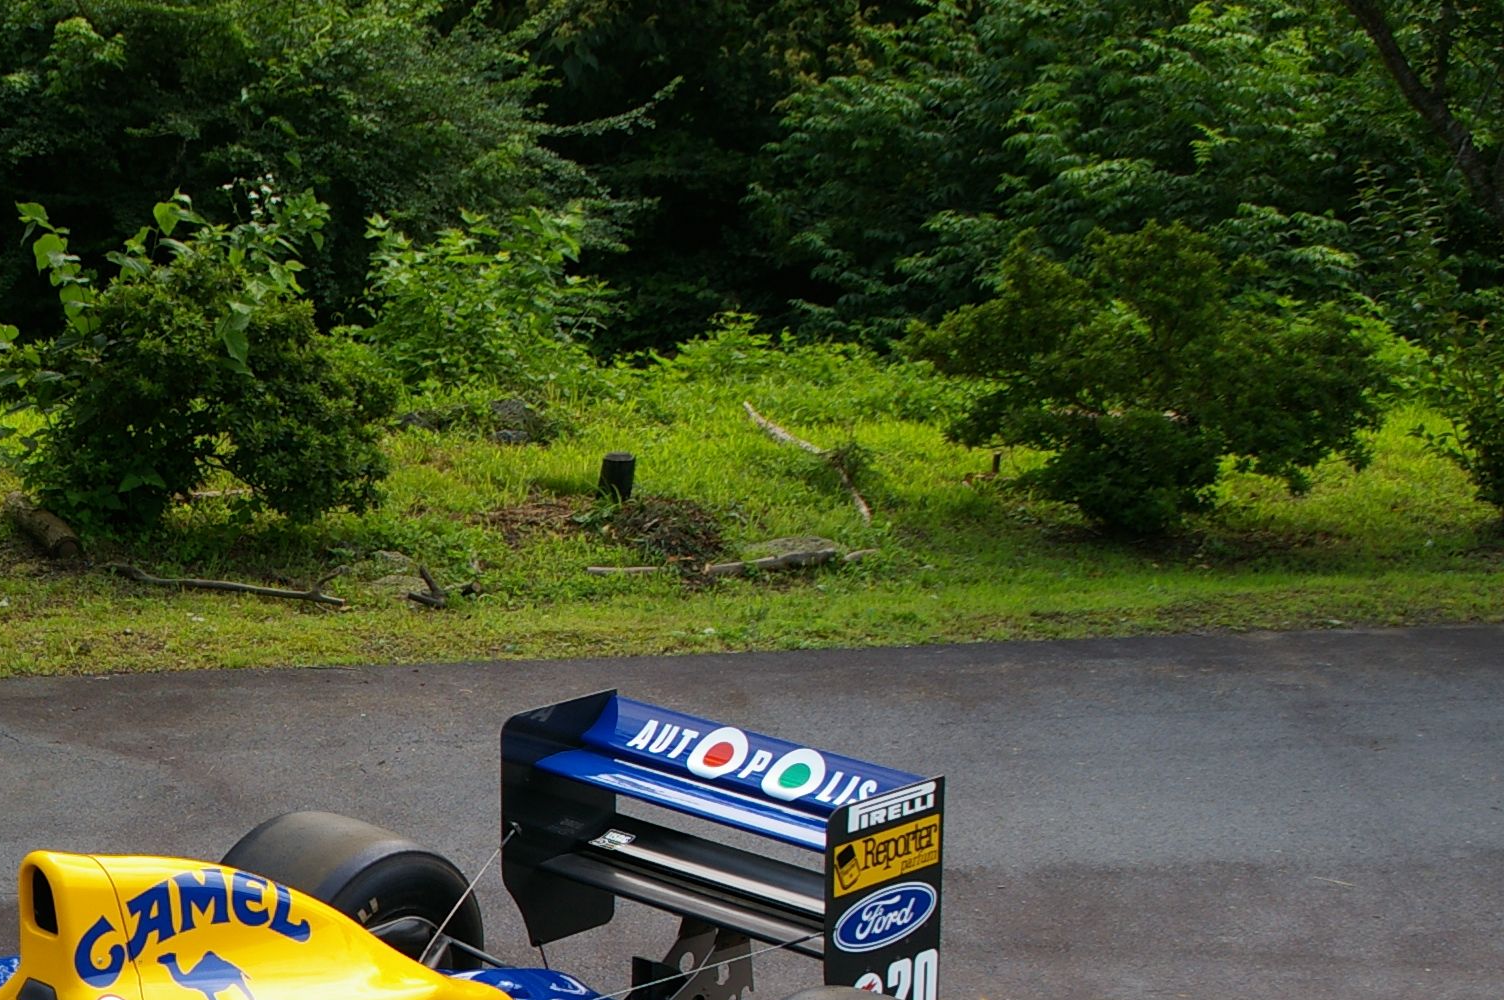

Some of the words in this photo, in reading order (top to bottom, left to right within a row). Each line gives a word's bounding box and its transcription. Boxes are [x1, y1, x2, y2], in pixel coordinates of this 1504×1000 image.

[627, 719, 877, 803] AUTOPOLIS
[847, 781, 937, 834] PIRELLI
[861, 823, 938, 871] Reporter
[900, 850, 937, 875] parfum
[74, 868, 312, 988] CAMEL
[854, 896, 916, 942] Ford
